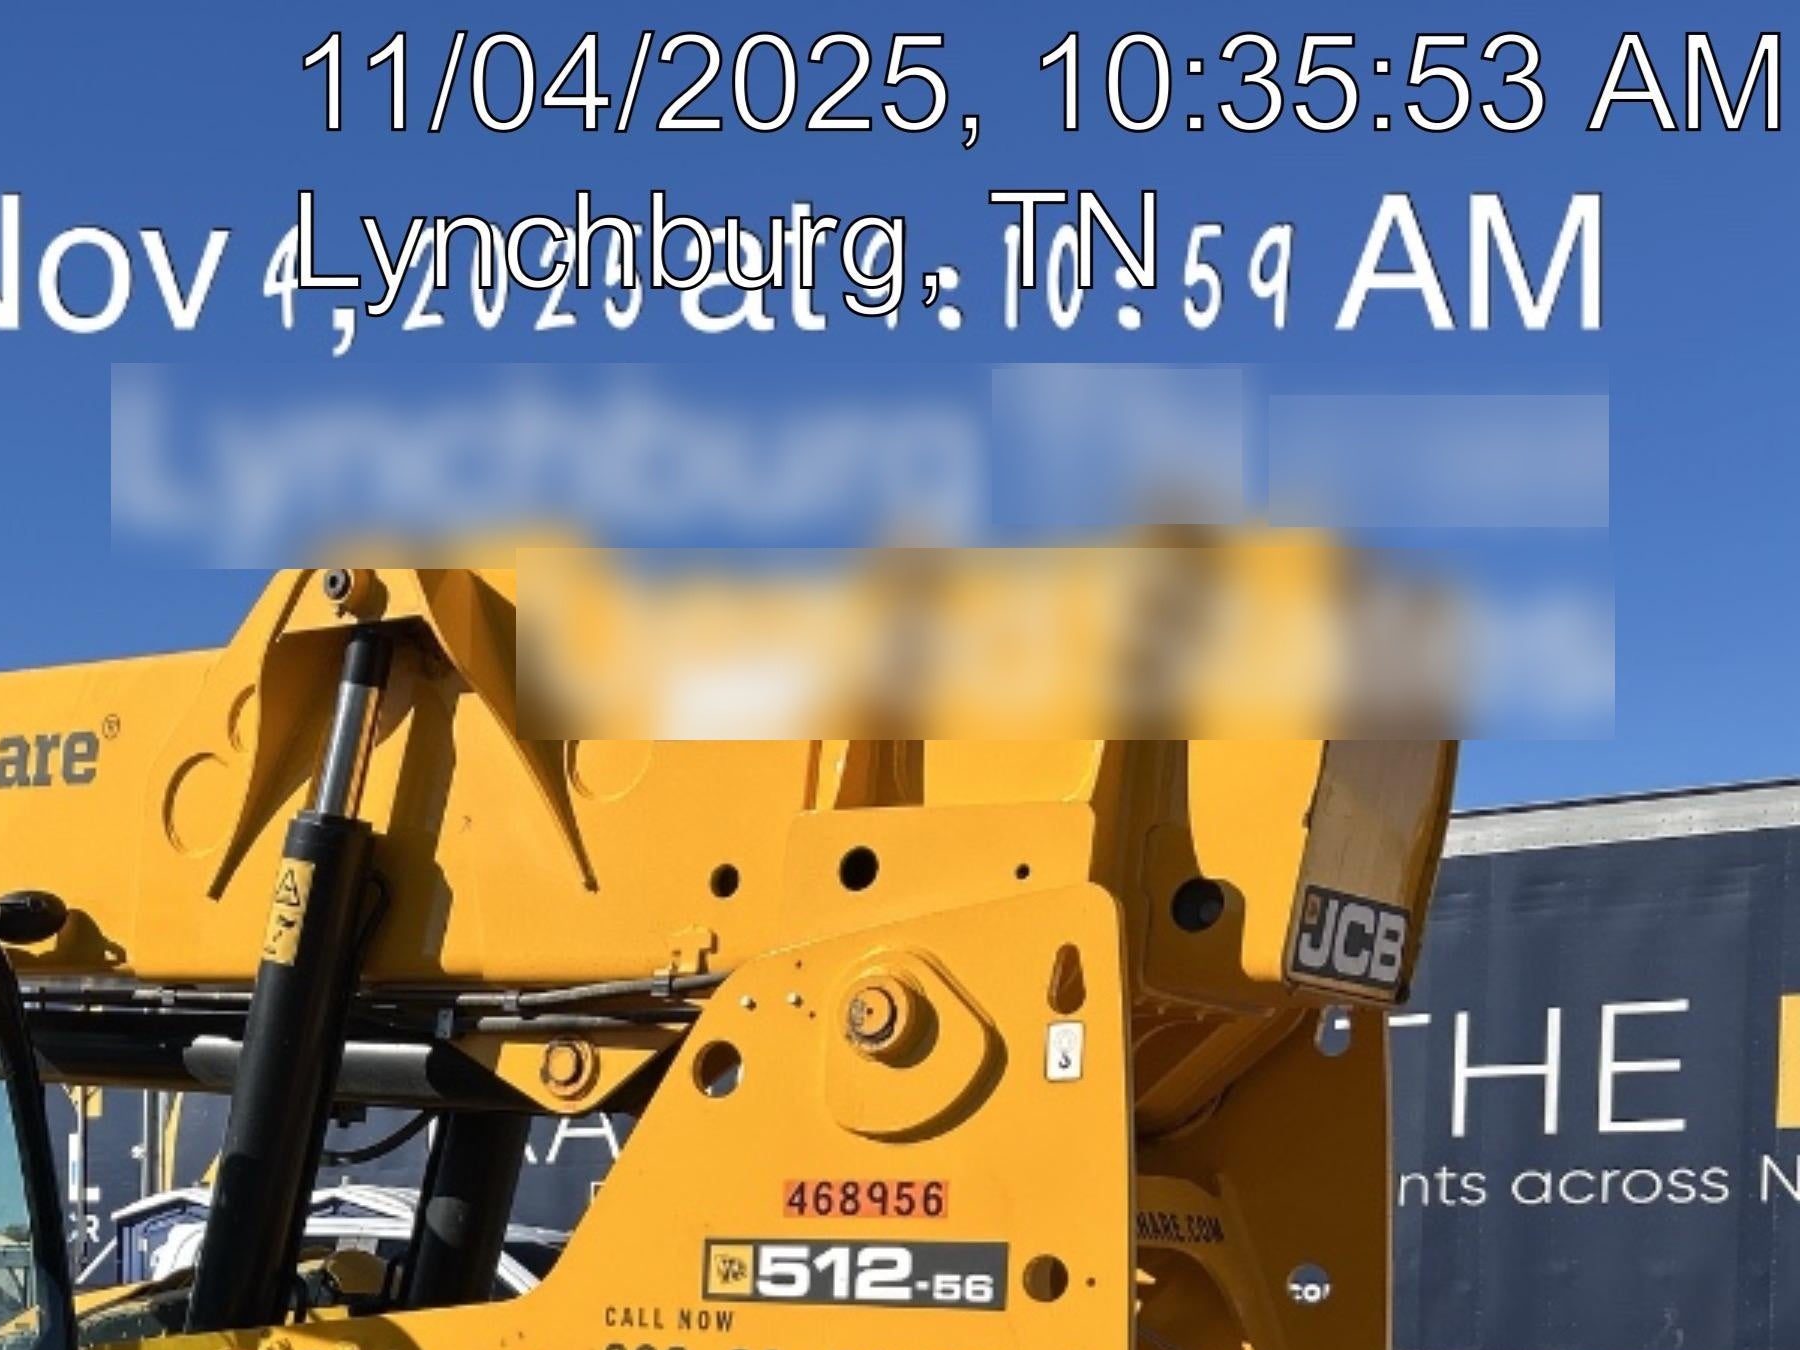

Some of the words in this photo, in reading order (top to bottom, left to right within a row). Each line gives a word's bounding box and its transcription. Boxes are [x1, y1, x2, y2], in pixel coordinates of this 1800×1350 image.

[1298, 899, 1406, 982] JCB
[787, 1180, 945, 1217] 468956
[1511, 1166, 1730, 1206] across
[756, 1245, 995, 1302] 512-56
[605, 1307, 665, 1330] CALL
[679, 1310, 735, 1333] NOW
